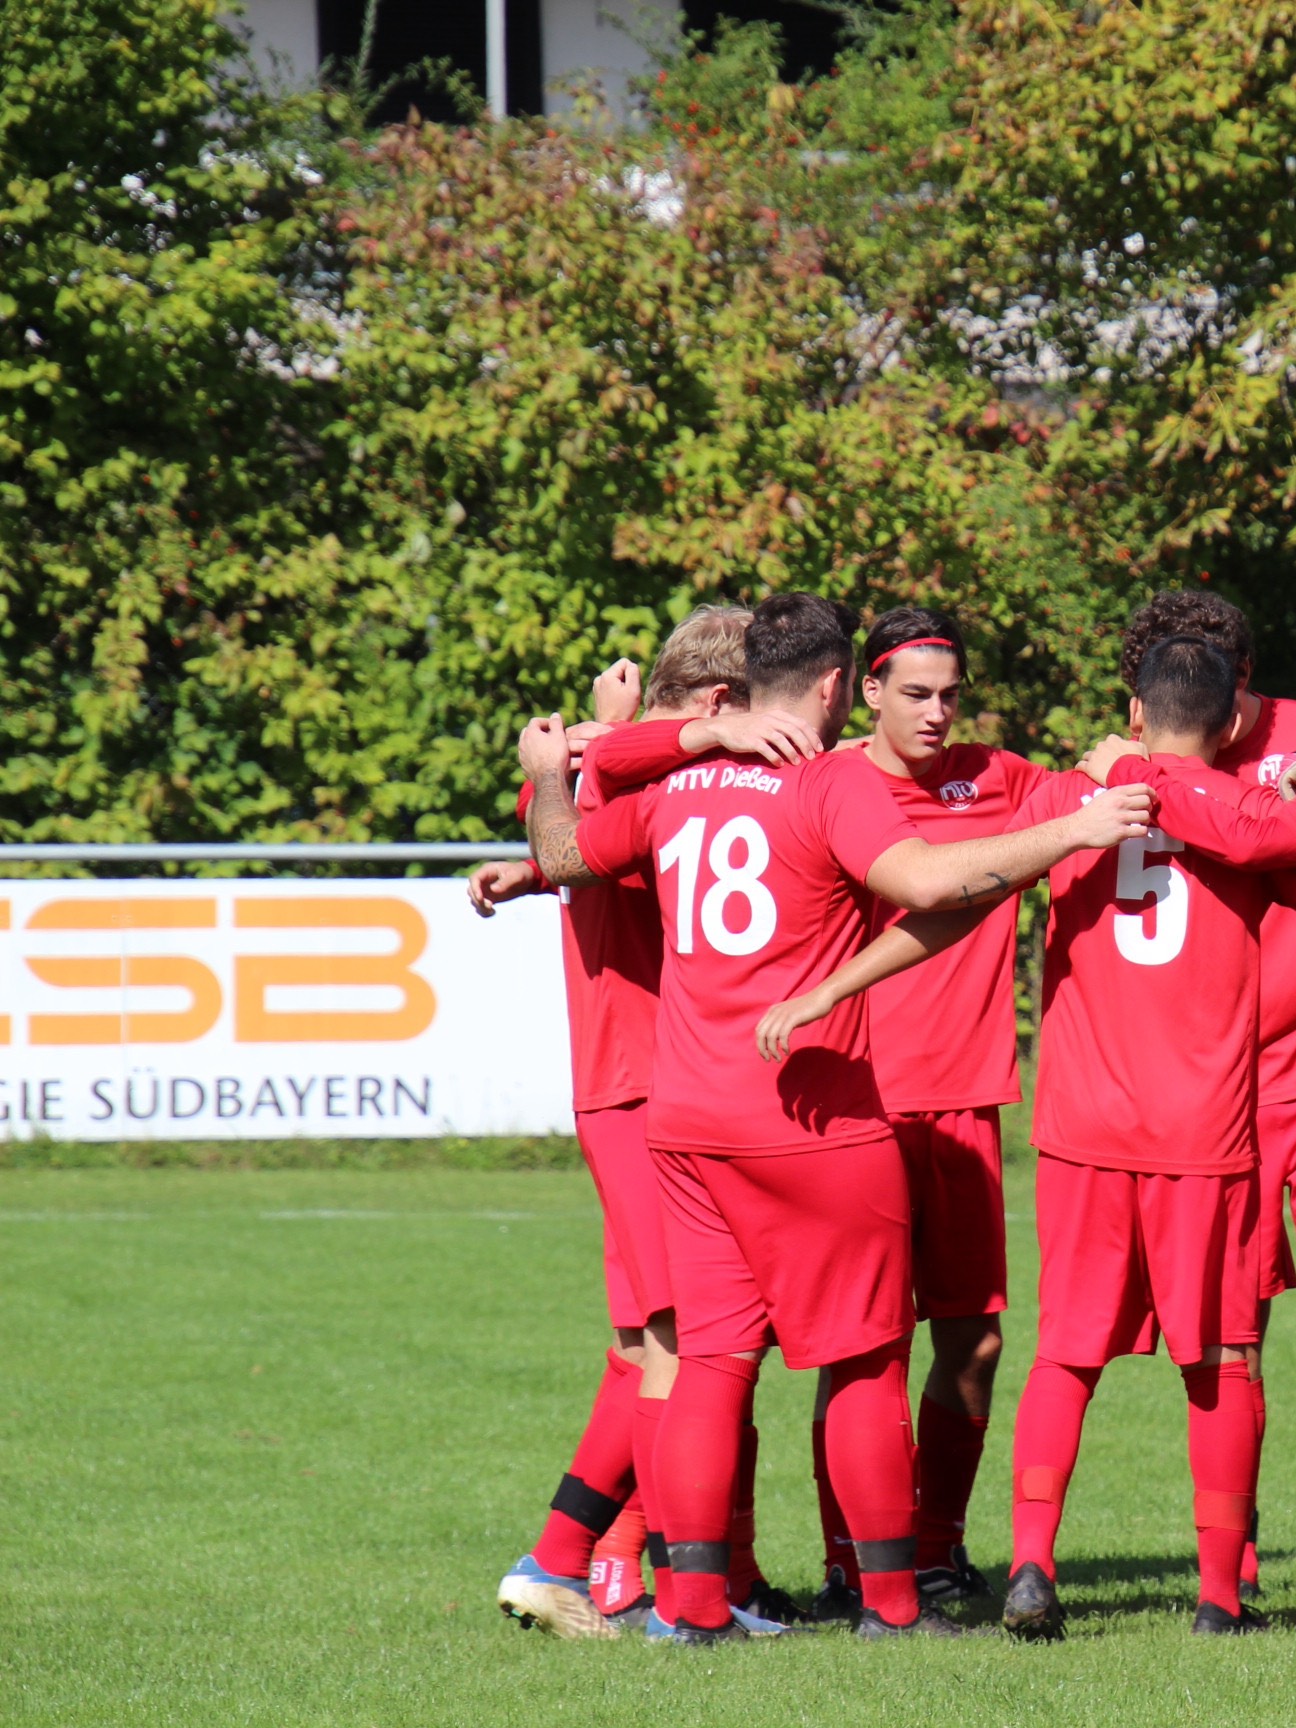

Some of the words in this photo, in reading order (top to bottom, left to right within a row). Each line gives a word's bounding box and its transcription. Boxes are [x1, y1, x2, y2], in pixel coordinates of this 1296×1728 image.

[666, 767, 717, 795] MTV
[719, 766, 783, 795] Dießen
[658, 815, 777, 956] 18
[1113, 823, 1189, 966] 5
[0, 895, 438, 1045] SB
[89, 1067, 432, 1121] SÜDBAYERN
